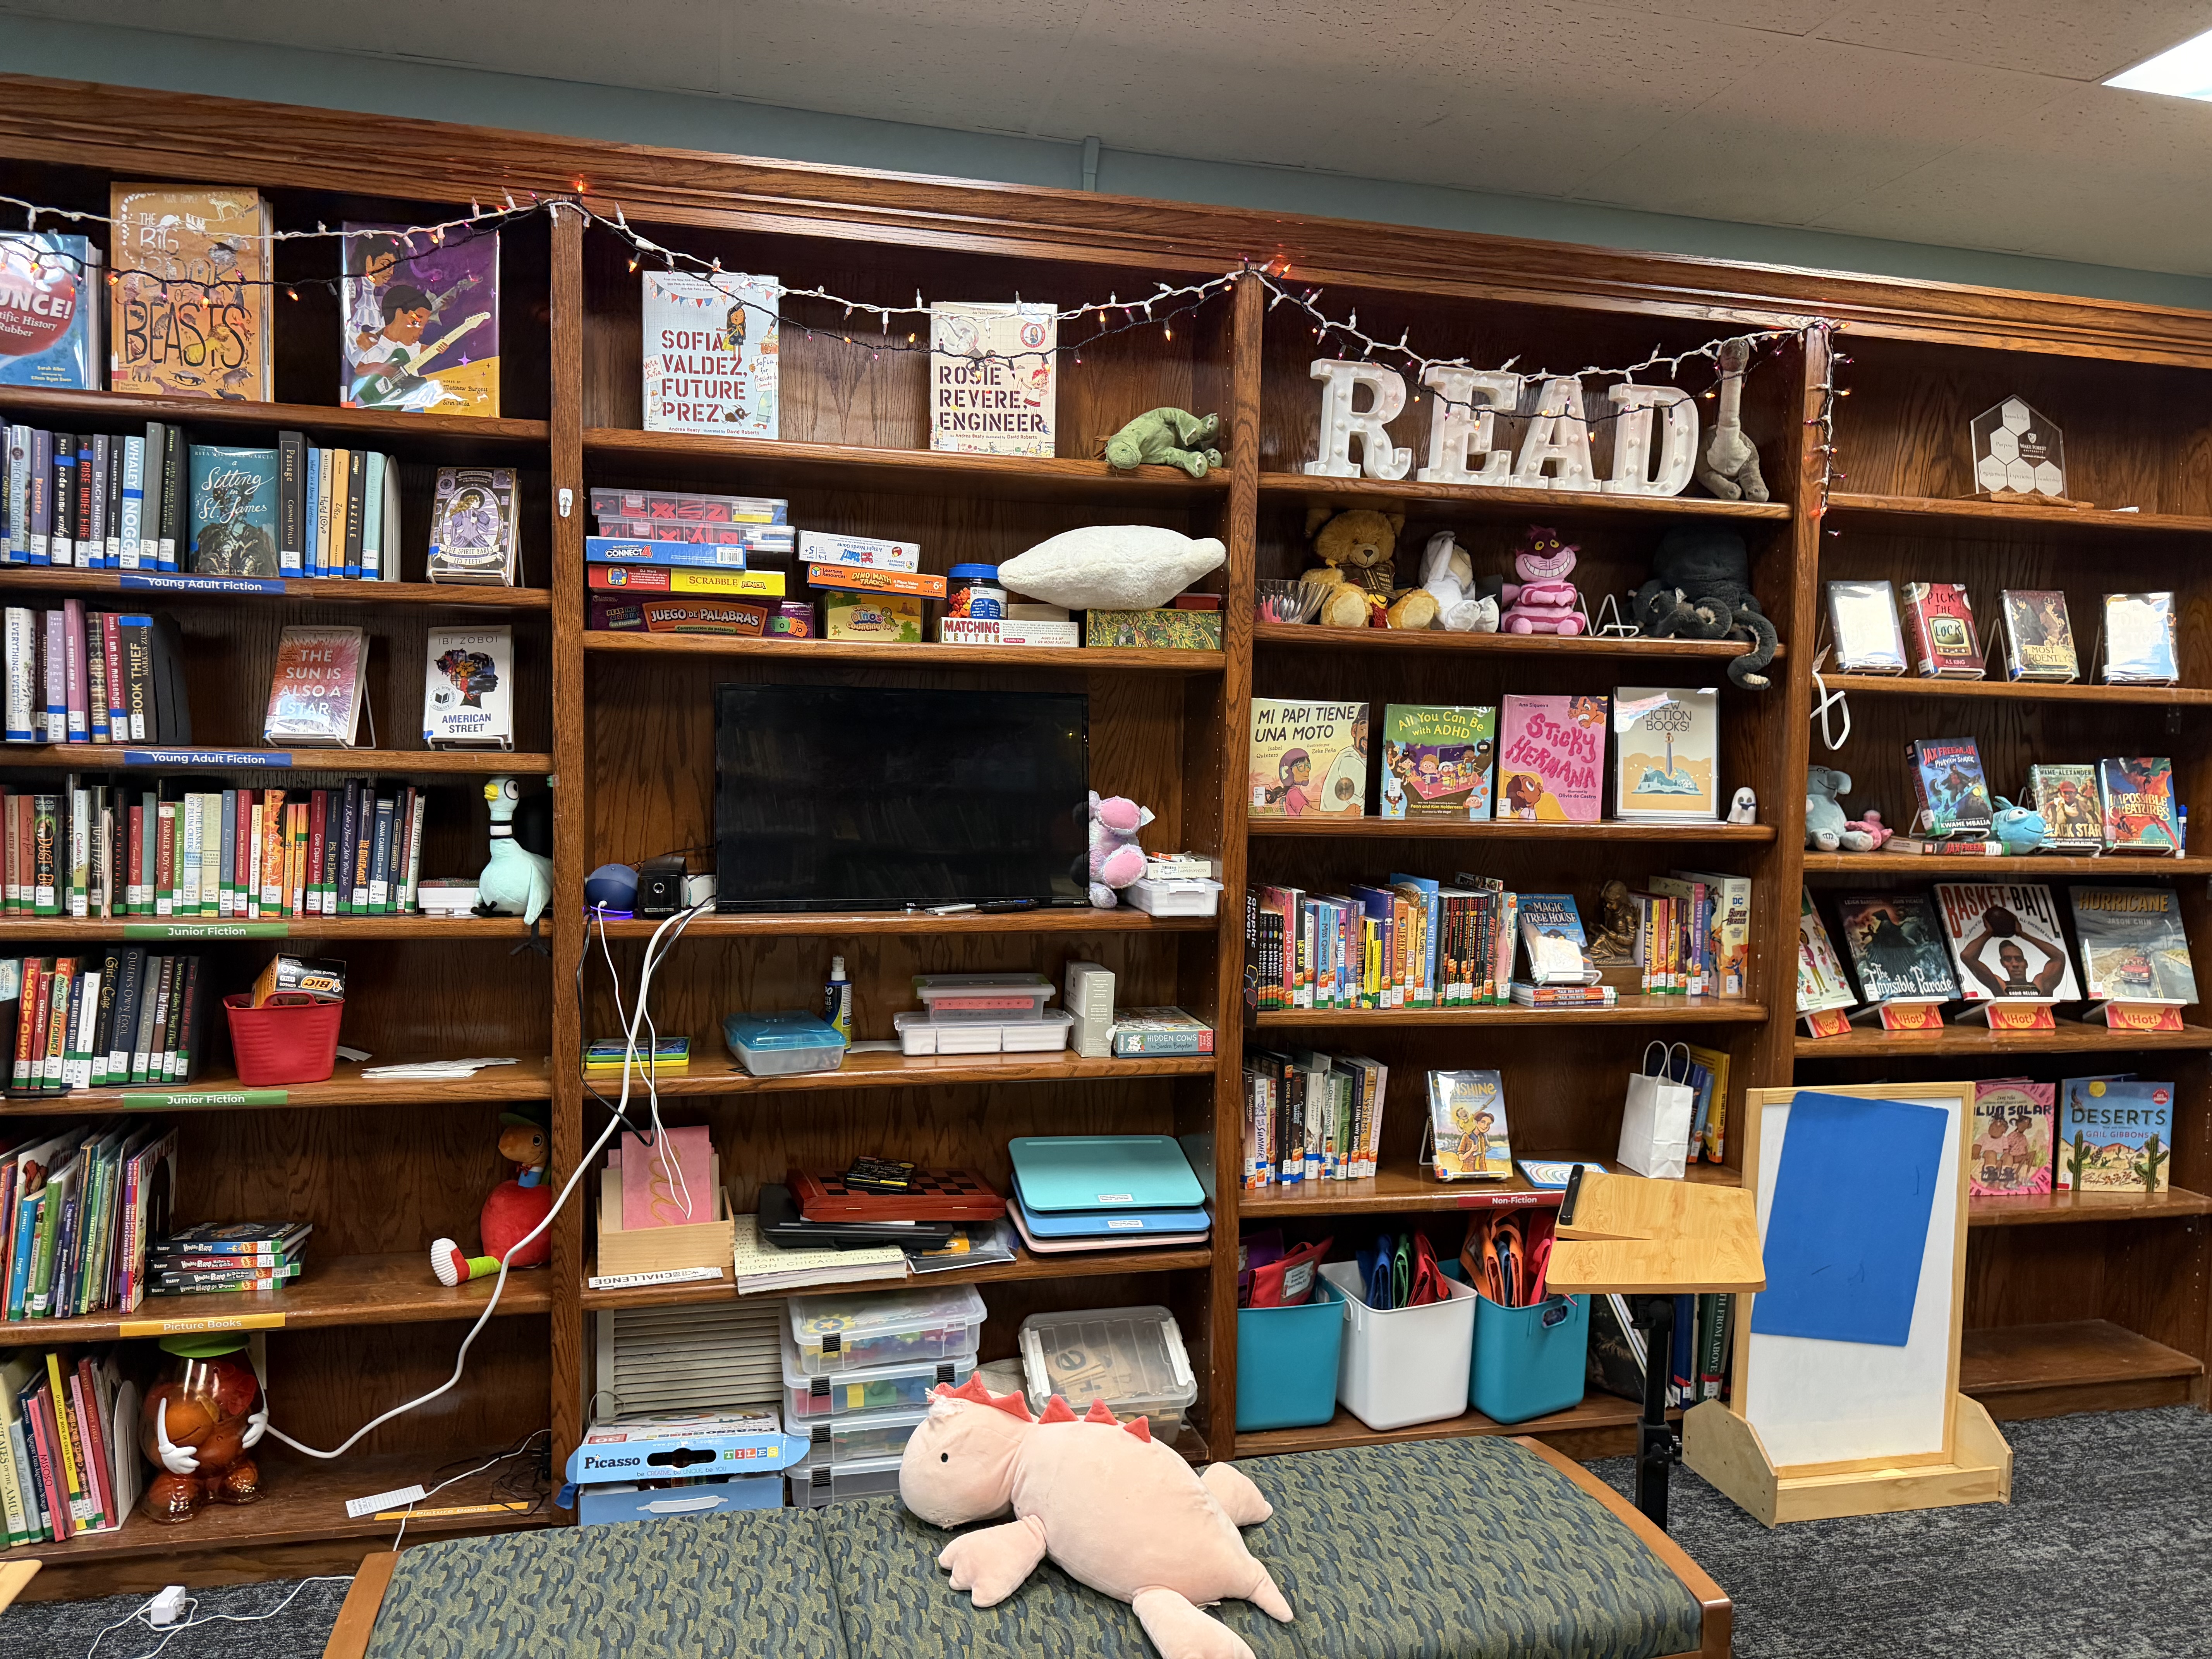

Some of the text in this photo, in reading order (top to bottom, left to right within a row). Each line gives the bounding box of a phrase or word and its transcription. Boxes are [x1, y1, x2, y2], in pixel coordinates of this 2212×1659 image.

[140, 213, 156, 225] THE
[141, 227, 179, 255] BIG
[0, 323, 34, 337] Rubber
[22, 316, 57, 331] History
[124, 301, 252, 369] BEASTS
[661, 330, 725, 352] SOFIA
[662, 354, 748, 378] VALDEZ,
[939, 366, 1001, 385] ROSIE
[662, 378, 746, 400] FUTURE
[940, 389, 1027, 411] REVERE,
[662, 402, 719, 422] PREZ
[940, 412, 1043, 432] ENGINEER
[1305, 358, 1698, 496] READ
[127, 440, 139, 488] WHALEY
[284, 449, 295, 483] Passage
[201, 467, 274, 495] Sitting
[11, 461, 21, 542] PIECING ME TOGETHER
[35, 478, 43, 514] Rooster
[199, 496, 268, 524] St. James
[349, 496, 359, 539] RAZZLE
[93, 505, 102, 540] MIRROR
[605, 545, 653, 558] CONNECT 4
[149, 578, 262, 591] Young Adult Fiction
[689, 575, 766, 589] SCRABBLE JUNIOR
[851, 572, 892, 584] DINO MATH
[860, 579, 884, 587] TRACKS
[933, 581, 943, 590] 6+
[1927, 592, 1956, 605] PICK
[651, 609, 687, 622] JUEGO
[700, 609, 759, 627] PALABRAS
[1935, 605, 1951, 614] THE
[944, 620, 1000, 634] MATCHING
[1935, 625, 1961, 637] LOCK
[944, 633, 999, 643] LETTER
[11, 622, 19, 672] EVERYTHING
[301, 649, 334, 662] THE
[286, 667, 342, 680] SUN IS
[111, 668, 120, 708] messenger
[279, 685, 341, 698] ALSO A
[287, 702, 330, 715] STAR
[1258, 706, 1355, 724] MI PAPI TIENE
[1642, 710, 1692, 721] FICTION
[442, 713, 491, 723] AMERICAN
[1398, 712, 1484, 732] All You Can Be
[1645, 720, 1690, 732] BOOKS!
[449, 723, 484, 733] STREET
[1255, 725, 1334, 742] UNA MOTO
[1412, 725, 1470, 739] with ADHD
[152, 754, 265, 764] Young Adult Fiction
[1505, 735, 1596, 788] HERMANA
[1923, 746, 1976, 765] JAX FREEMAN
[2109, 804, 2171, 821] CREATURES
[2045, 823, 2102, 838] BLACK STAR
[1532, 902, 1564, 913] MAGIC
[1731, 894, 1743, 907] DC
[2078, 892, 2169, 913] HURRICANE
[1523, 911, 1577, 923] TREE HOUSE
[1728, 908, 1747, 919] SUPER
[1939, 885, 2062, 939] BASKET BALL
[168, 926, 246, 936] Junior Fiction
[1397, 926, 1406, 959] MEXIKID
[280, 965, 297, 974] 60
[1870, 962, 1888, 980] The
[304, 979, 331, 988] BIC
[1863, 966, 1954, 995] Invisible Parade
[22, 968, 35, 1020] FRONT
[120, 952, 138, 1036] QUEEN'S OWN FOOL
[167, 1095, 245, 1104] Junior Fiction
[2008, 1105, 2052, 1116] SOLAR
[2071, 1108, 2166, 1125] DESERTS
[594, 1273, 672, 1285] CHALLENGE
[163, 1319, 242, 1331] Picture Books
[1710, 1309, 1725, 1372] FROM ABOVE
[584, 1446, 778, 1469] Picasso TILES
[39, 1454, 53, 1487] MISOSO
